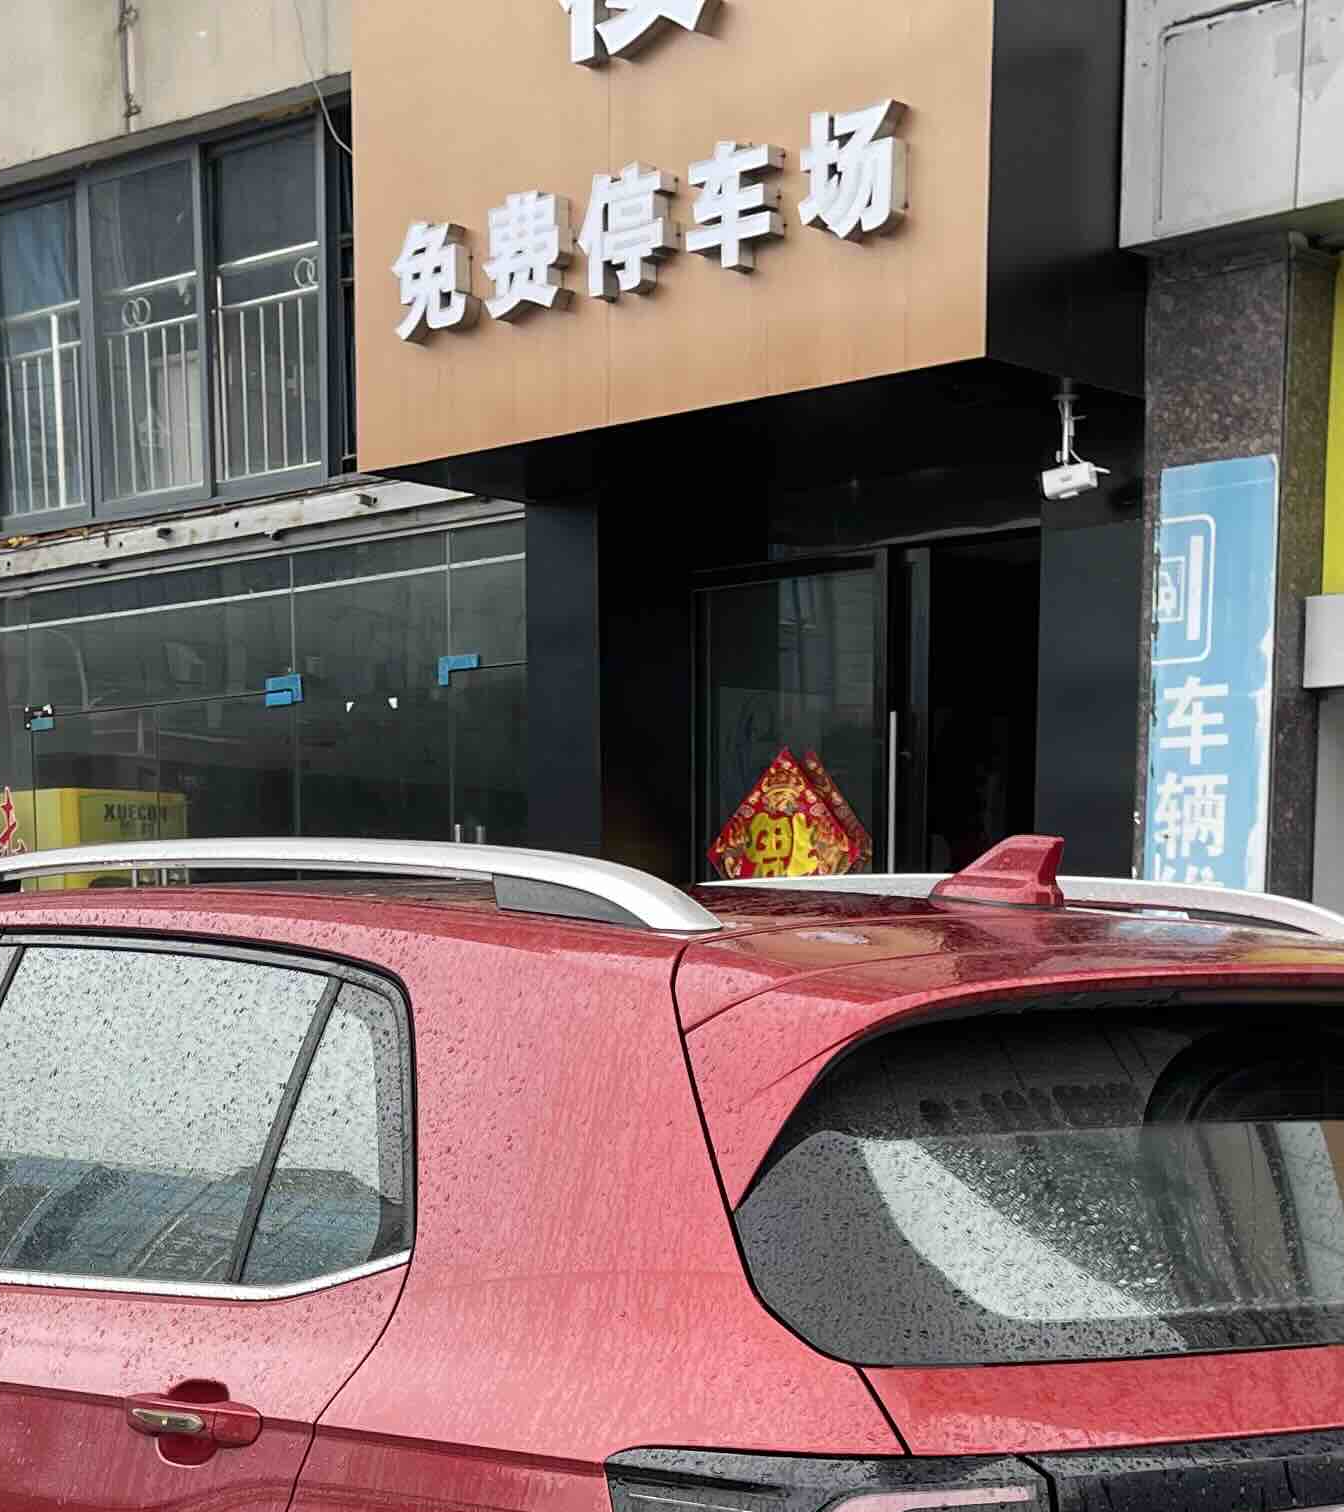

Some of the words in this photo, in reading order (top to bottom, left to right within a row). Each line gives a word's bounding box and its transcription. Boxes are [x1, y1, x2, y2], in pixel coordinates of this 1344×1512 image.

[392, 100, 908, 345] 免费停车场
